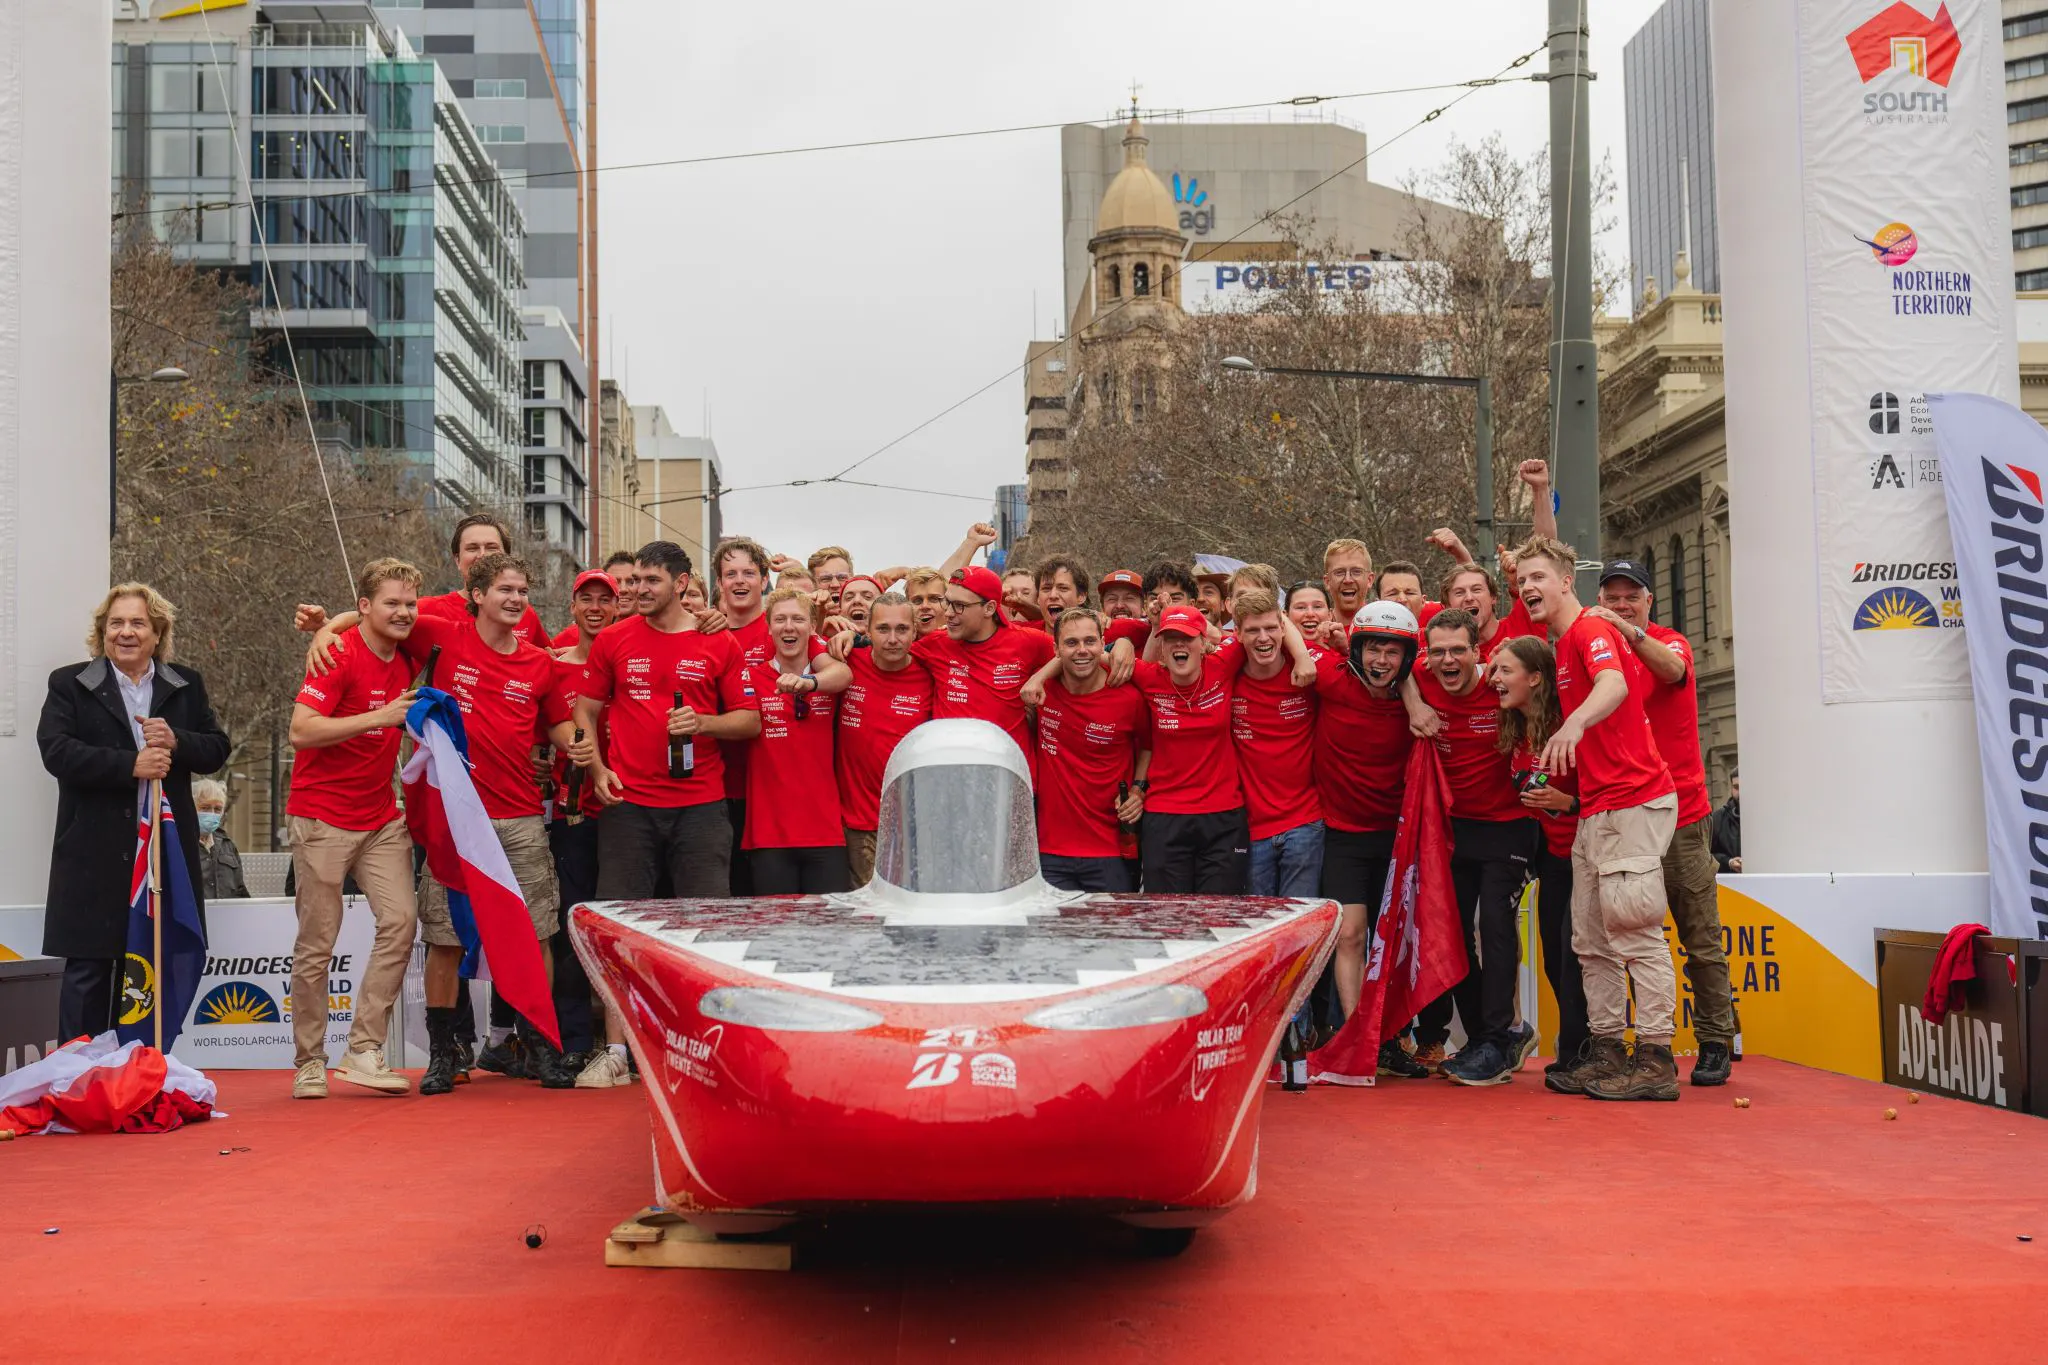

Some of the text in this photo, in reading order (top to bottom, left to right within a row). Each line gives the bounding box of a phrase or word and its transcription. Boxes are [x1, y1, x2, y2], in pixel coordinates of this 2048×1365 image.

[1863, 91, 1948, 113] SOUTH
[1865, 114, 1949, 125] AUSTRALIA
[1179, 203, 1215, 235] agl
[1893, 271, 1971, 292] NORTHERN
[1892, 294, 1972, 316] TERRITORY
[666, 1029, 711, 1062] SOLAR TEAM
[919, 1028, 978, 1048] 21
[1197, 1024, 1244, 1049] SOLAR TEAM
[666, 1049, 692, 1077] TWENTE
[1197, 1048, 1228, 1073] TWENTE
[1899, 1003, 2006, 1106] ADELAIDE
